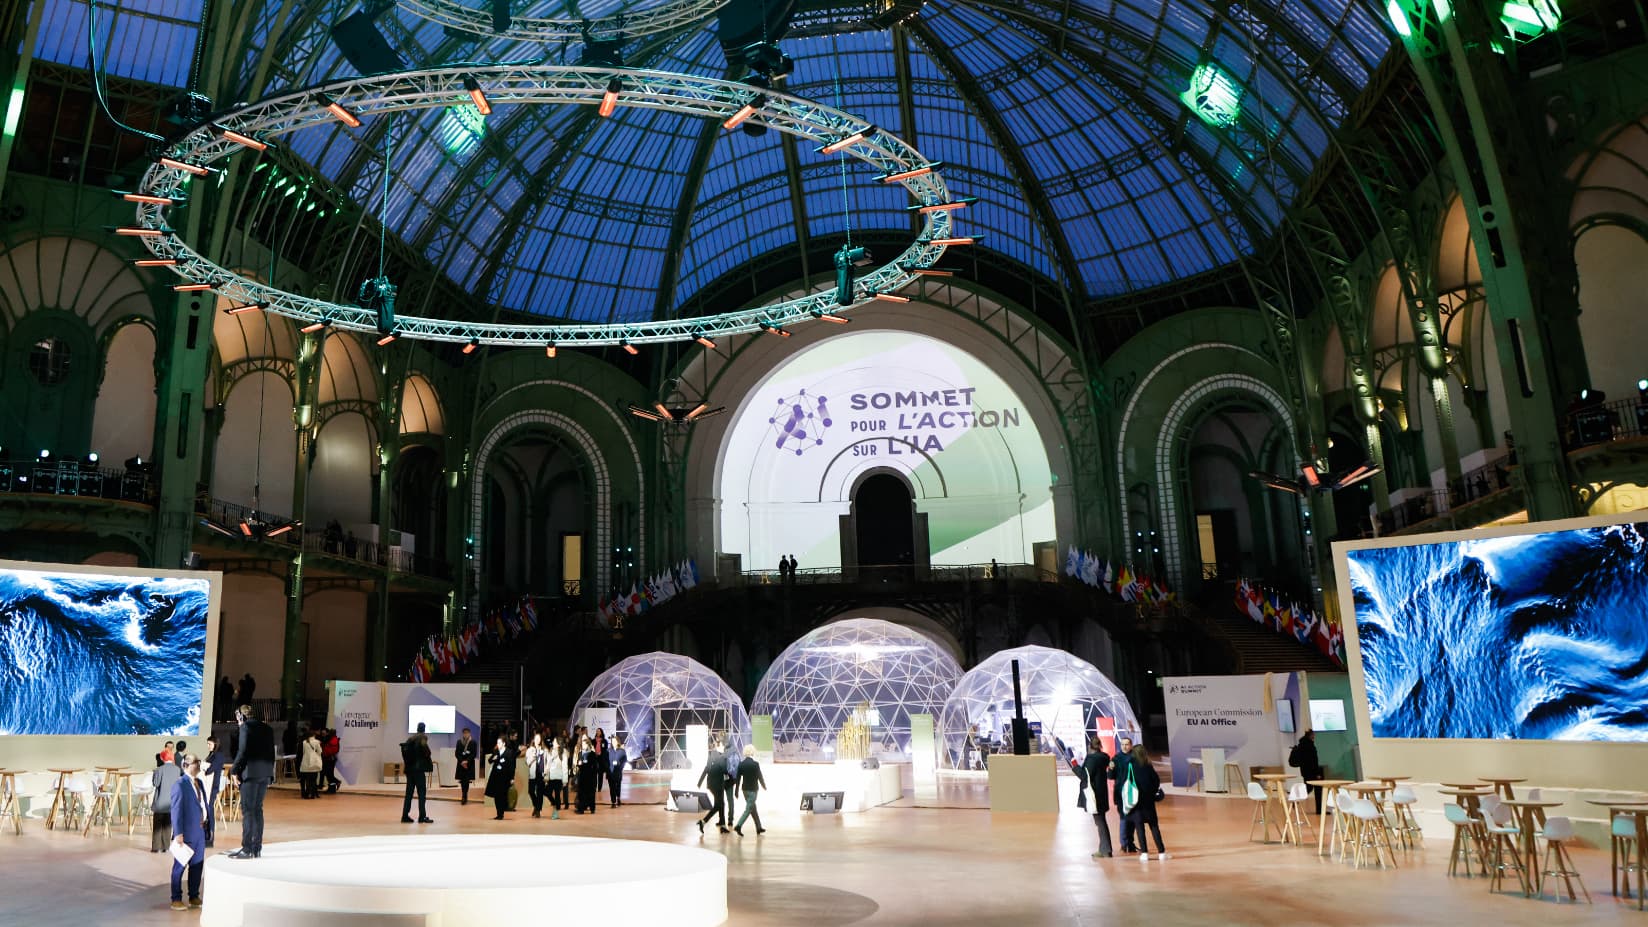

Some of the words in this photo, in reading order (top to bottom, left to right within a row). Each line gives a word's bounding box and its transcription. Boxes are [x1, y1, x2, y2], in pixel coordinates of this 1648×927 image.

[850, 387, 976, 410] SOMMET
[850, 420, 886, 432] POUR
[899, 407, 1020, 430] L'ACTION
[853, 445, 877, 456] SUR
[888, 434, 944, 455] L'IA
[1175, 708, 1213, 717] European
[1214, 707, 1263, 717] Commission
[350, 719, 379, 730] Challenges
[1187, 718, 1198, 726] EU
[1201, 718, 1209, 726] AI
[1211, 718, 1237, 726] Office
